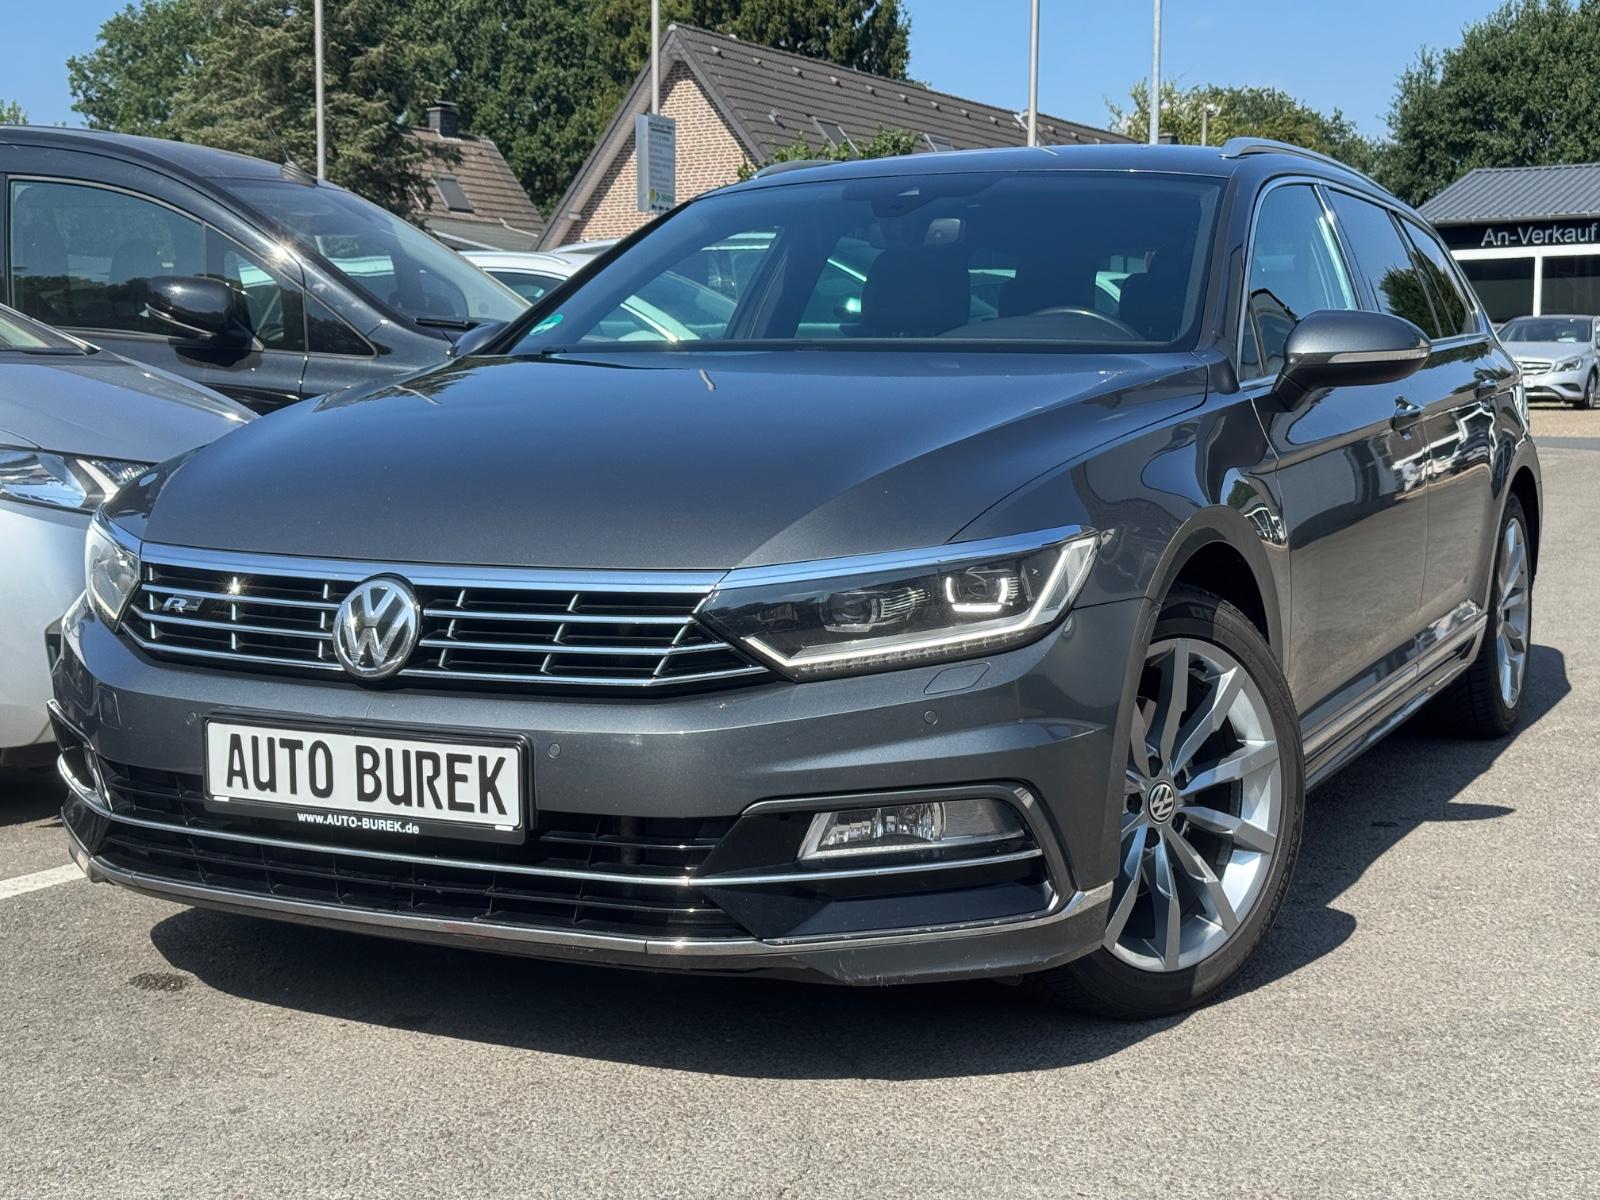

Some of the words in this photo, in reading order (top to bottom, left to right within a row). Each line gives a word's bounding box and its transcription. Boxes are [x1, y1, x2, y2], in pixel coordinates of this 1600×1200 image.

[1480, 223, 1597, 247] An-Verkauf
[334, 577, 419, 679] VW
[226, 733, 334, 798] AUTO
[355, 744, 507, 815] BUREK
[297, 812, 420, 835] www.AUTO-BUREK.de
